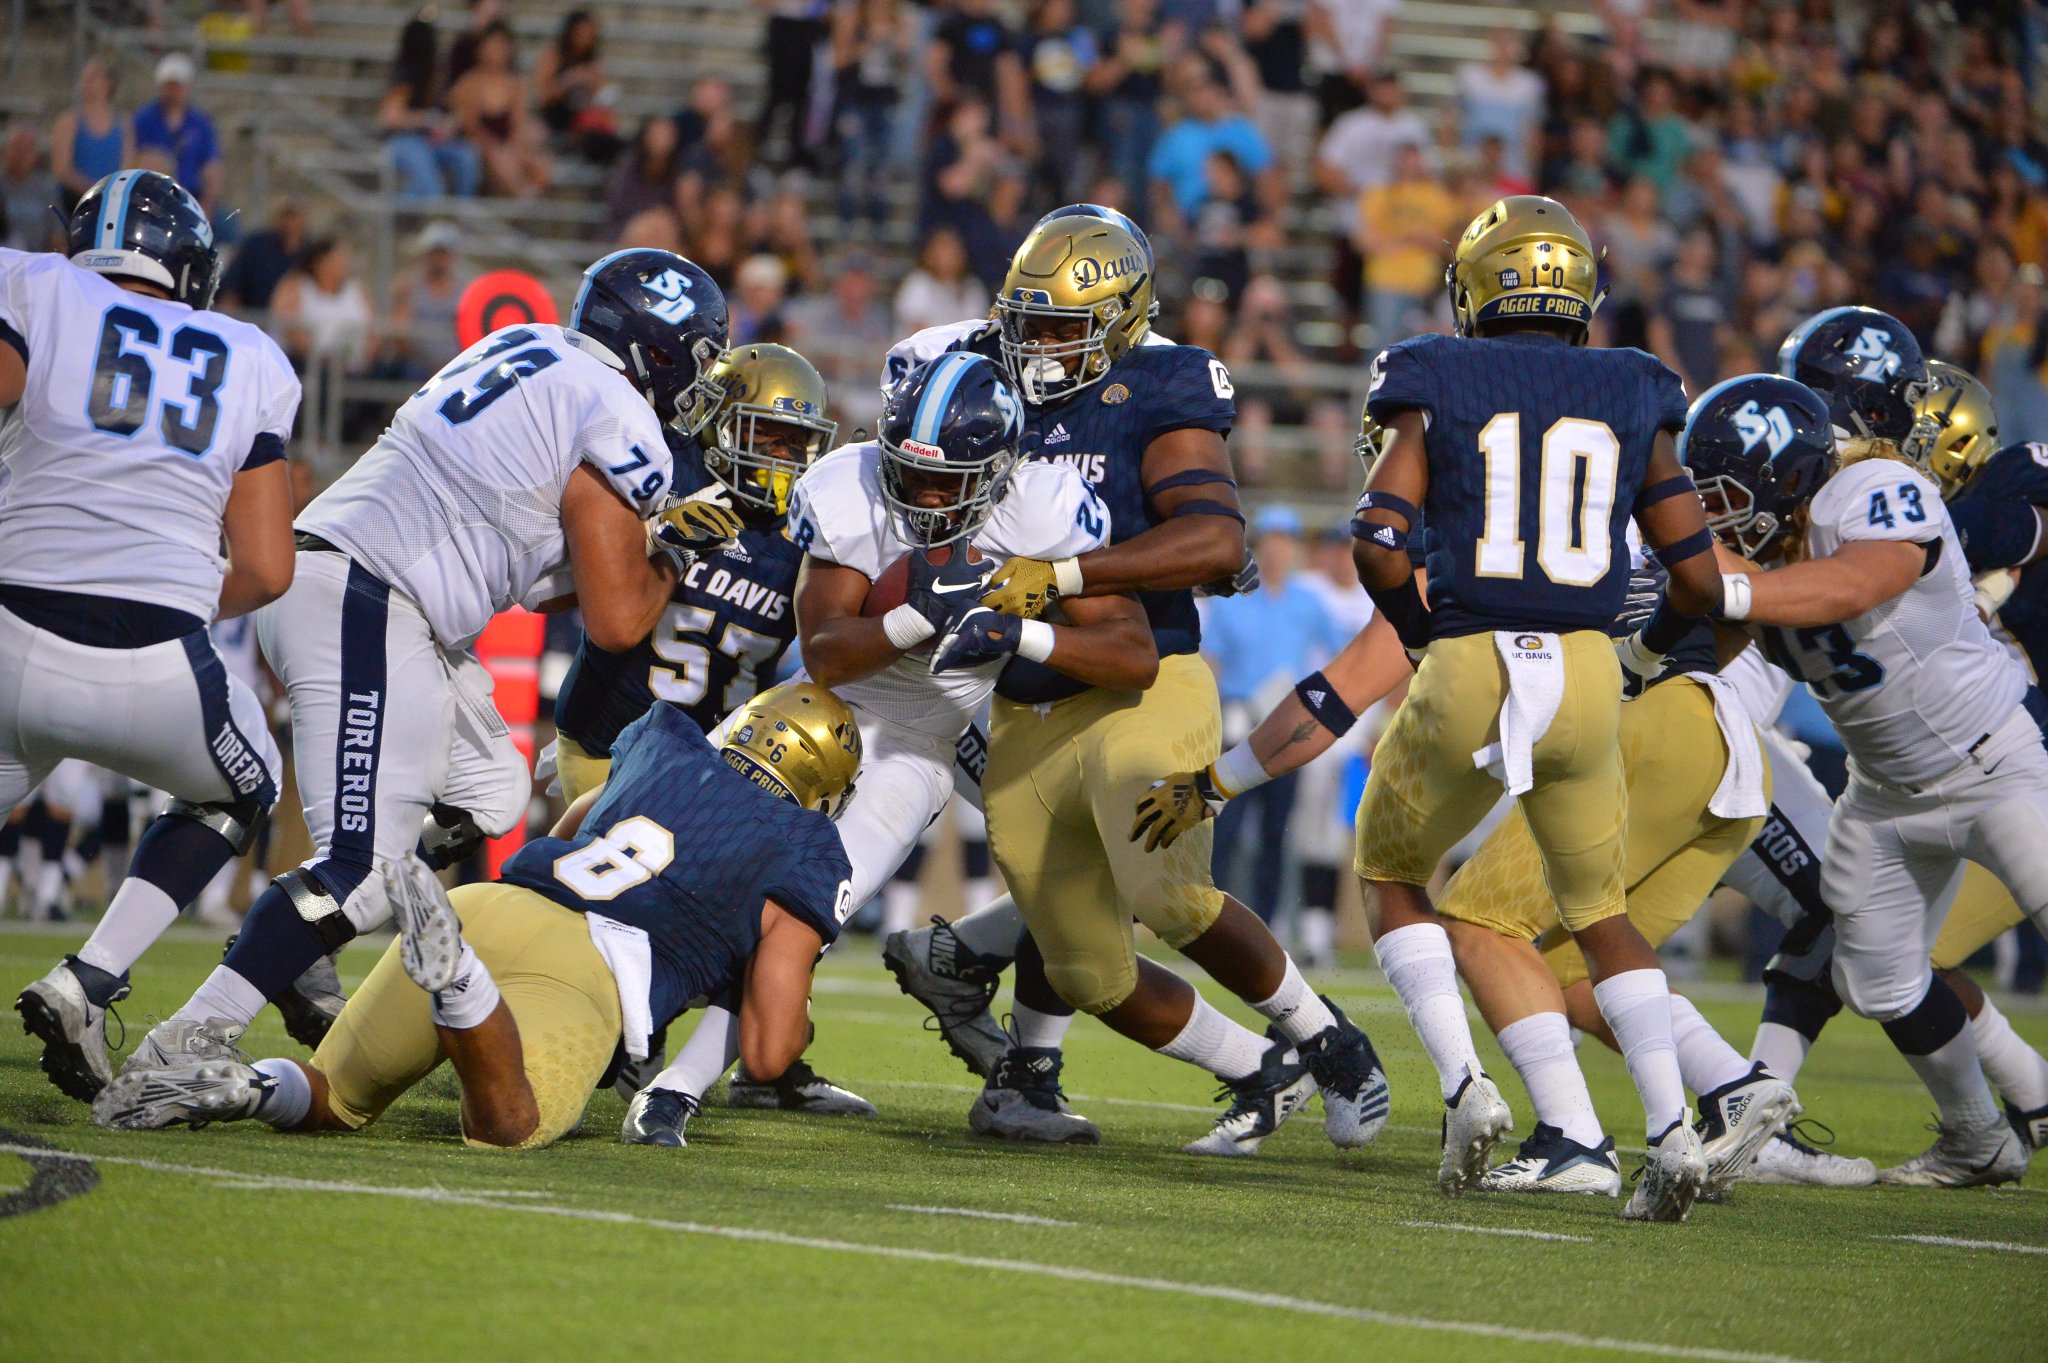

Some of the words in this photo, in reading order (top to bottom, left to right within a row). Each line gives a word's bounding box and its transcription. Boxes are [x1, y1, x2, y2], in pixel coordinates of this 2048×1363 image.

[1073, 247, 1144, 292] Davis
[1531, 265, 1564, 289] 10
[641, 267, 696, 325] SD
[1498, 297, 1540, 314] AGGIE
[1545, 297, 1583, 317] PRIDE
[86, 303, 232, 460] 63
[904, 442, 938, 459] Riddell
[1044, 433, 1071, 445] adidas
[1730, 400, 1795, 463] SD
[608, 443, 667, 501] 79
[1475, 412, 1621, 588] 10
[1867, 481, 1927, 530] 43
[723, 549, 753, 564] adidas
[1373, 531, 1396, 547] adidas
[683, 561, 709, 589] C
[705, 568, 790, 622] DAVIS
[648, 601, 782, 712] 57
[1525, 652, 1552, 660] DAVIS
[341, 690, 379, 833] TOREROS
[724, 750, 752, 775] AGGIE
[750, 769, 790, 799] PRIDE
[770, 743, 788, 764] 6
[553, 815, 675, 901] 6
[931, 926, 956, 979] NIKE
[1730, 1092, 1755, 1128] adidas
